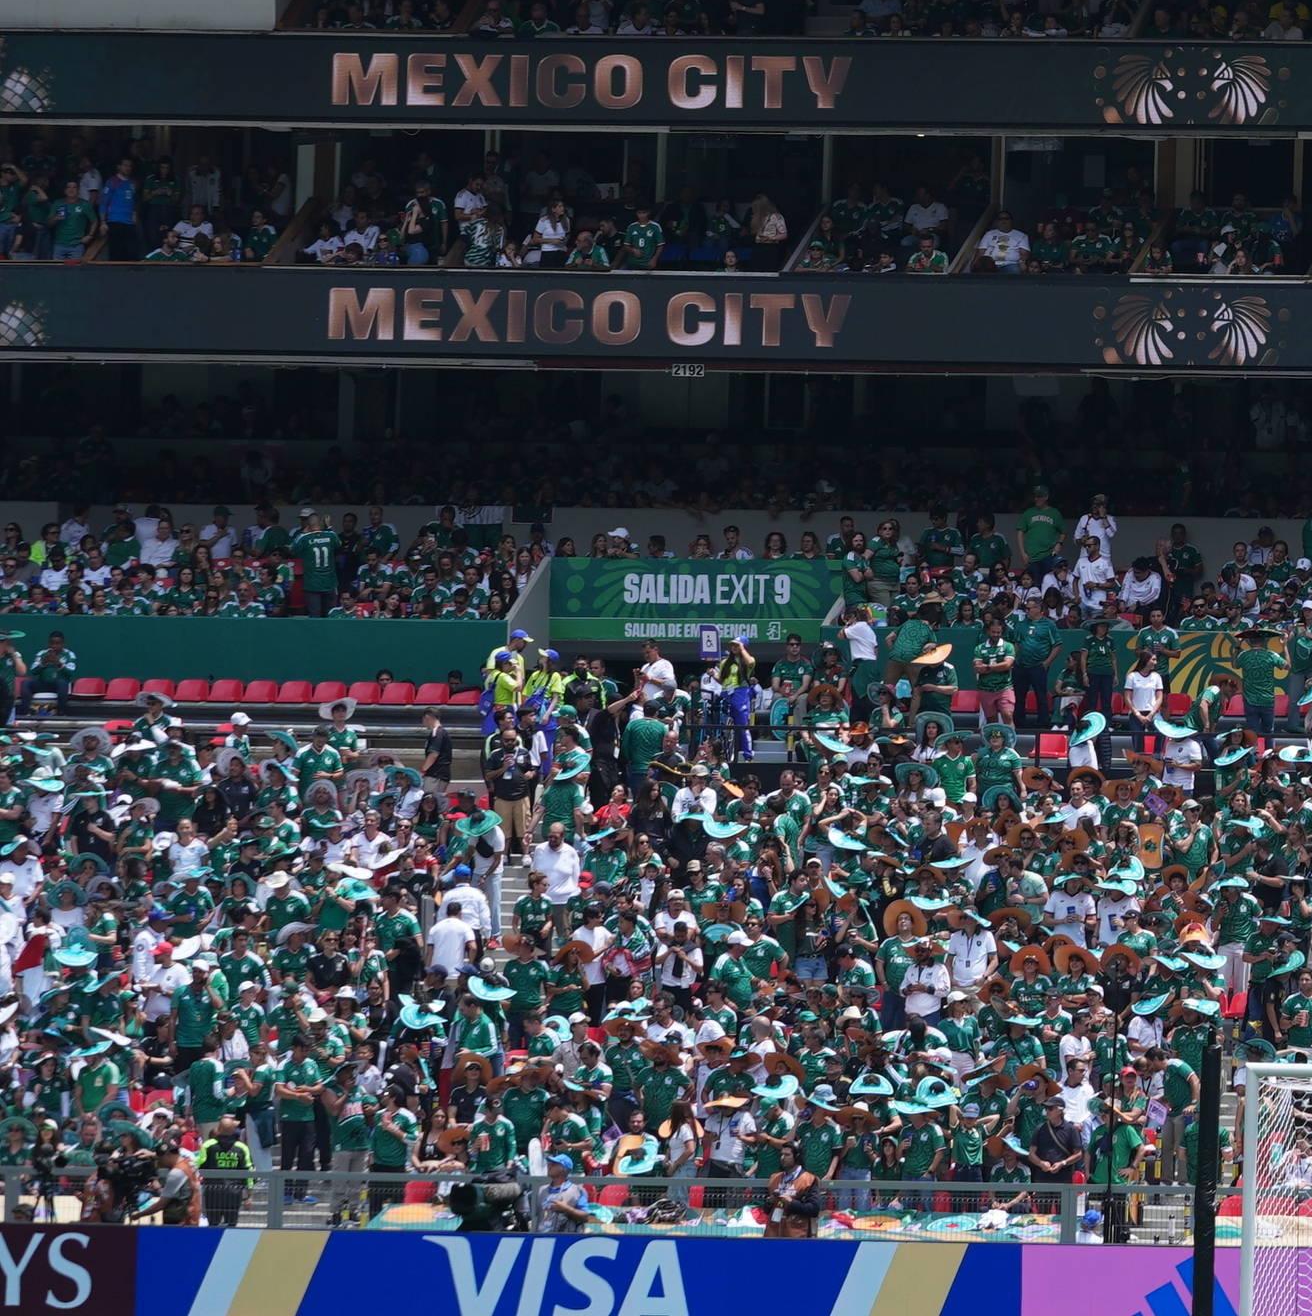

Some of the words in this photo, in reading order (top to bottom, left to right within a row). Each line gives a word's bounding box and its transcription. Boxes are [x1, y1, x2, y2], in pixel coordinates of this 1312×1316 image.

[331, 52, 644, 109] MEXICO
[668, 54, 853, 110] CITY
[327, 286, 642, 346] MEXICO
[665, 290, 853, 348] CITY
[674, 364, 704, 377] 2192
[313, 546, 330, 568] 11
[623, 573, 711, 604] SALIDA
[715, 574, 770, 605] EXIT
[774, 574, 791, 605] 9
[624, 622, 665, 639] SALIDA
[668, 623, 681, 639] DE
[683, 623, 758, 639] EMGENCIA
[215, 1152, 240, 1161] LOCAL
[422, 1235, 690, 1316] VISA
